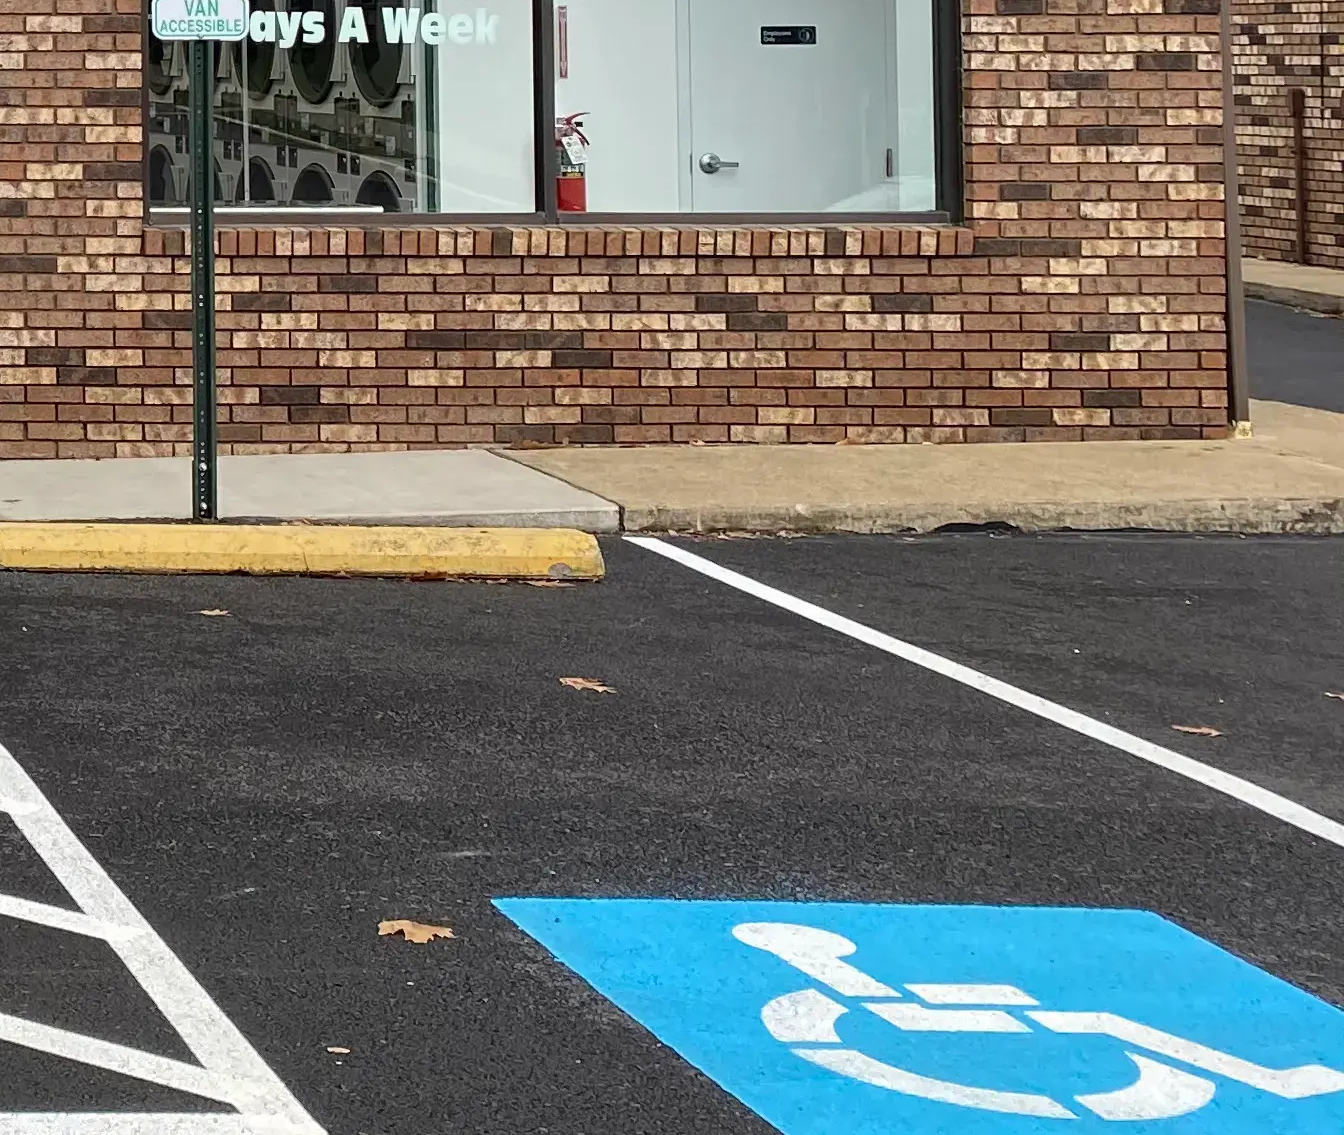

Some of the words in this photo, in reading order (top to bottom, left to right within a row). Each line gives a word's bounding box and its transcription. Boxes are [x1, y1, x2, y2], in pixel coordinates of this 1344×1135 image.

[184, 0, 219, 16] VAN
[160, 18, 242, 33] ACCESSIBLE
[250, 9, 325, 49] ays
[338, 7, 369, 43] A
[382, 6, 500, 44] Week
